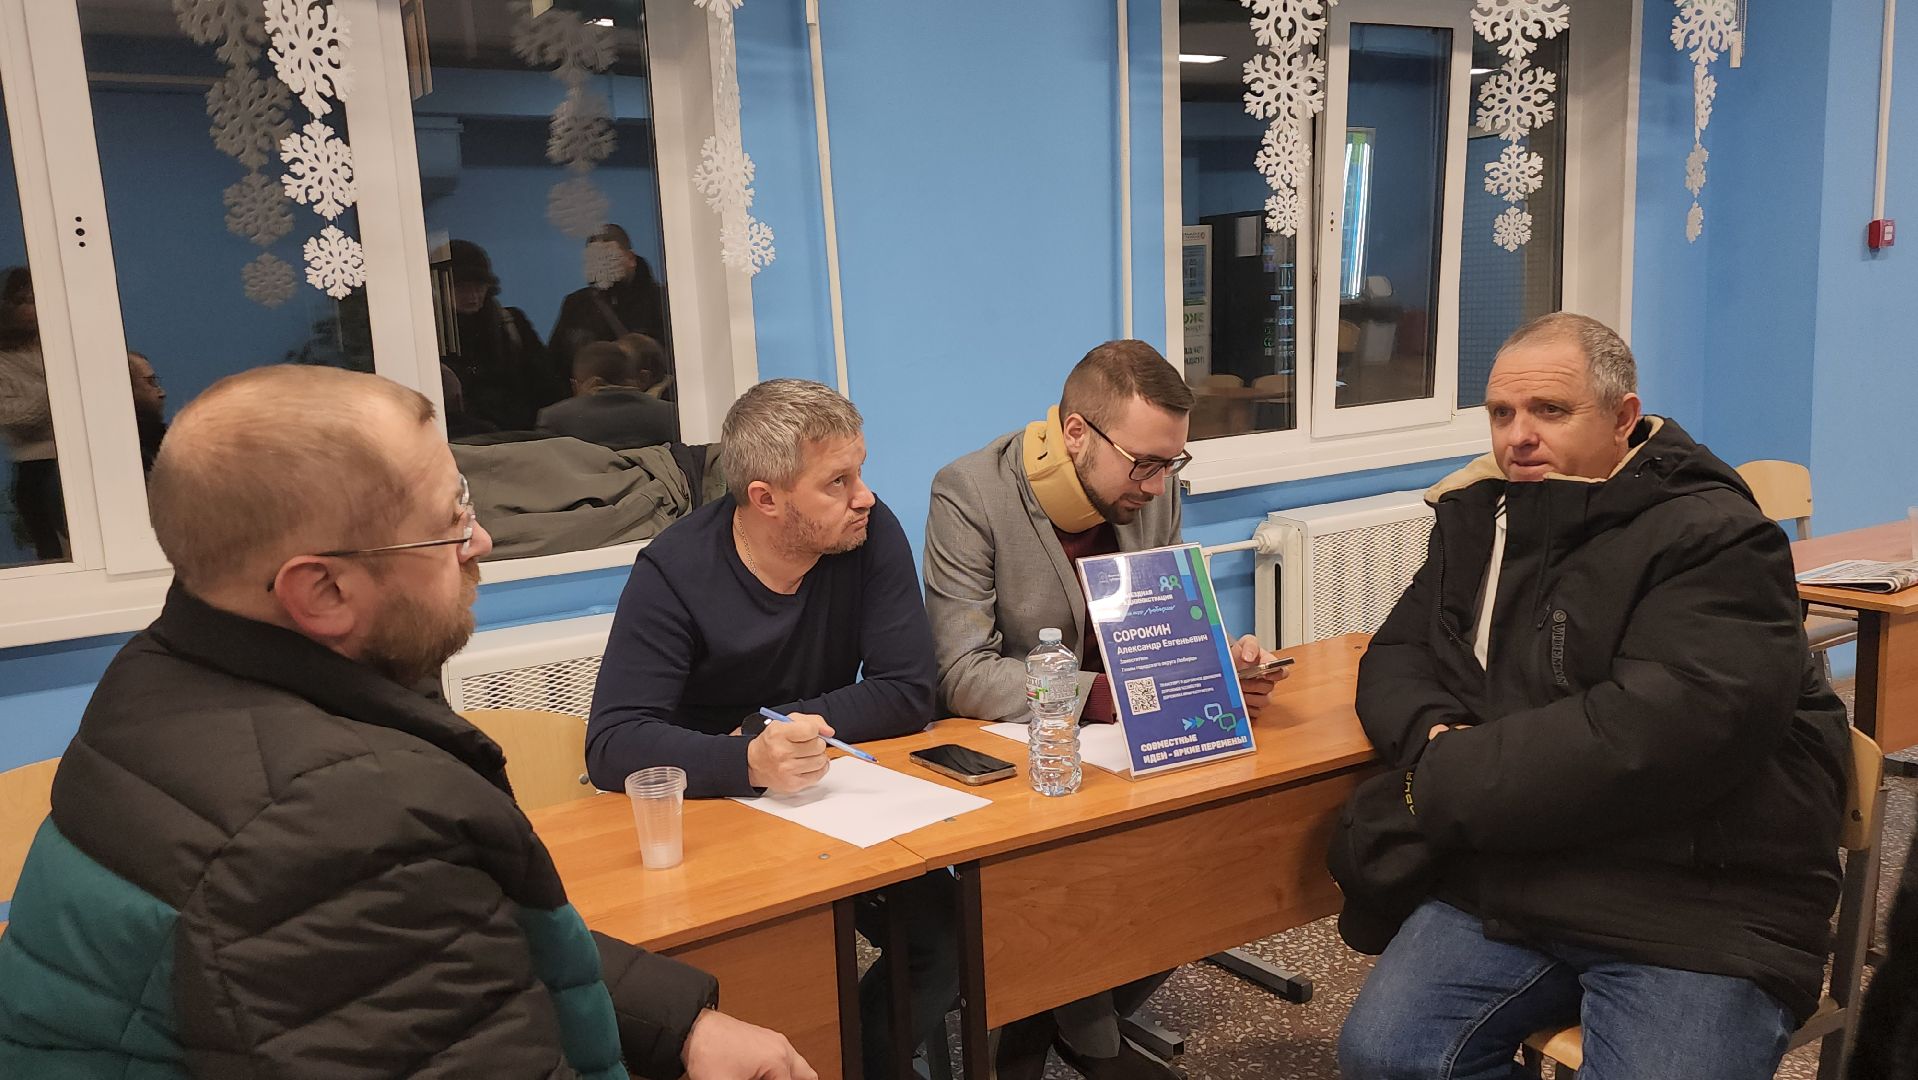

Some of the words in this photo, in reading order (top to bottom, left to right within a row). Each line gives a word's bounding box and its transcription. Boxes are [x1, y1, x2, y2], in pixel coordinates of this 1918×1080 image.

[1112, 622, 1172, 643] СОРОКИН
[1116, 641, 1161, 656] Александр
[1162, 634, 1208, 647] Евгеньевич
[1140, 734, 1198, 752] СОВМЕСТНЫЕ
[1143, 750, 1168, 765] ИДЕИ
[1172, 744, 1201, 757] ЯРКИЕ
